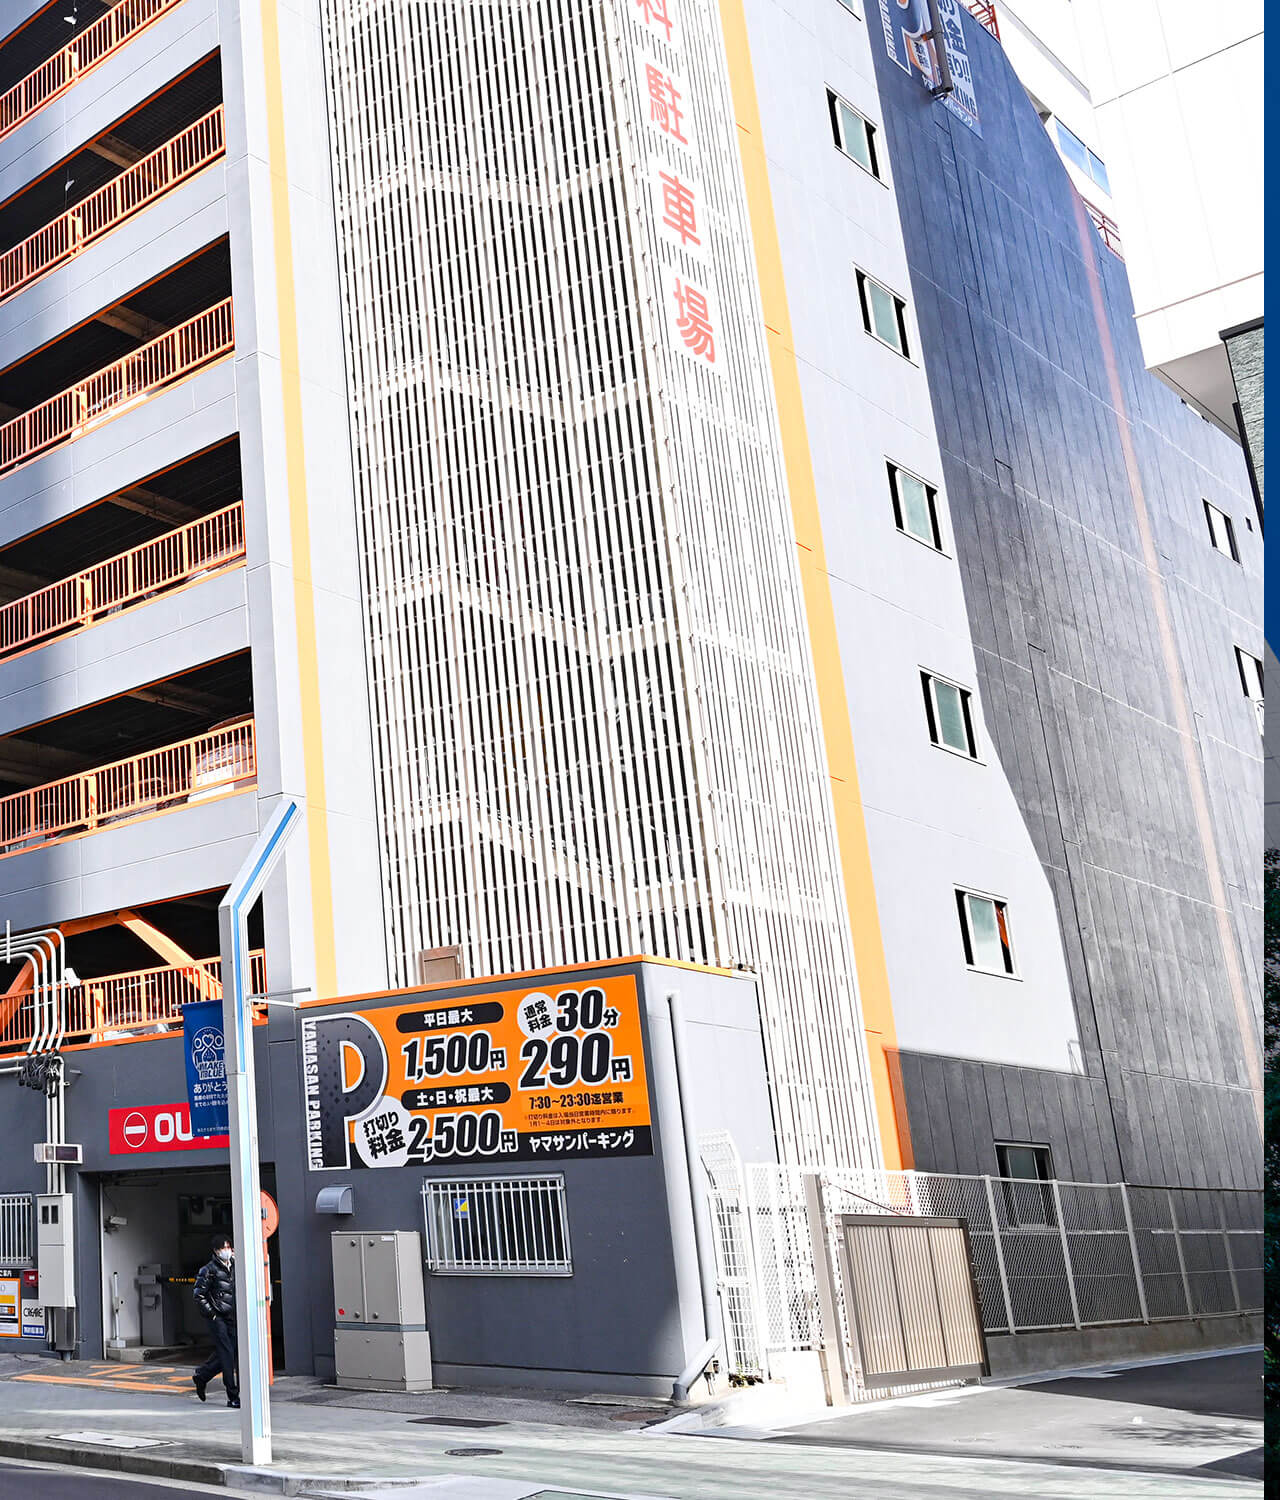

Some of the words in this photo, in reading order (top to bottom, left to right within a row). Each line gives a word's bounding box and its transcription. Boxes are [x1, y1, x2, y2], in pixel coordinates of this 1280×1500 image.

[424, 1008, 474, 1028] 平日最大
[524, 1000, 548, 1020] 通常
[528, 1015, 553, 1033] 料金
[556, 989, 620, 1033] 30分
[303, 1020, 320, 1096] YAMASAN
[403, 1032, 507, 1082] 1,500円
[520, 1032, 631, 1088] 290円
[316, 1014, 388, 1170] P
[417, 1087, 494, 1107] 土・日・祝最大
[154, 1111, 211, 1144] OU
[307, 1098, 324, 1168] PARKING
[363, 1111, 399, 1137] 打切り
[407, 1112, 518, 1161] 2,500円
[368, 1128, 406, 1159] 料金
[529, 1129, 634, 1153] ヤマサンパーキング
